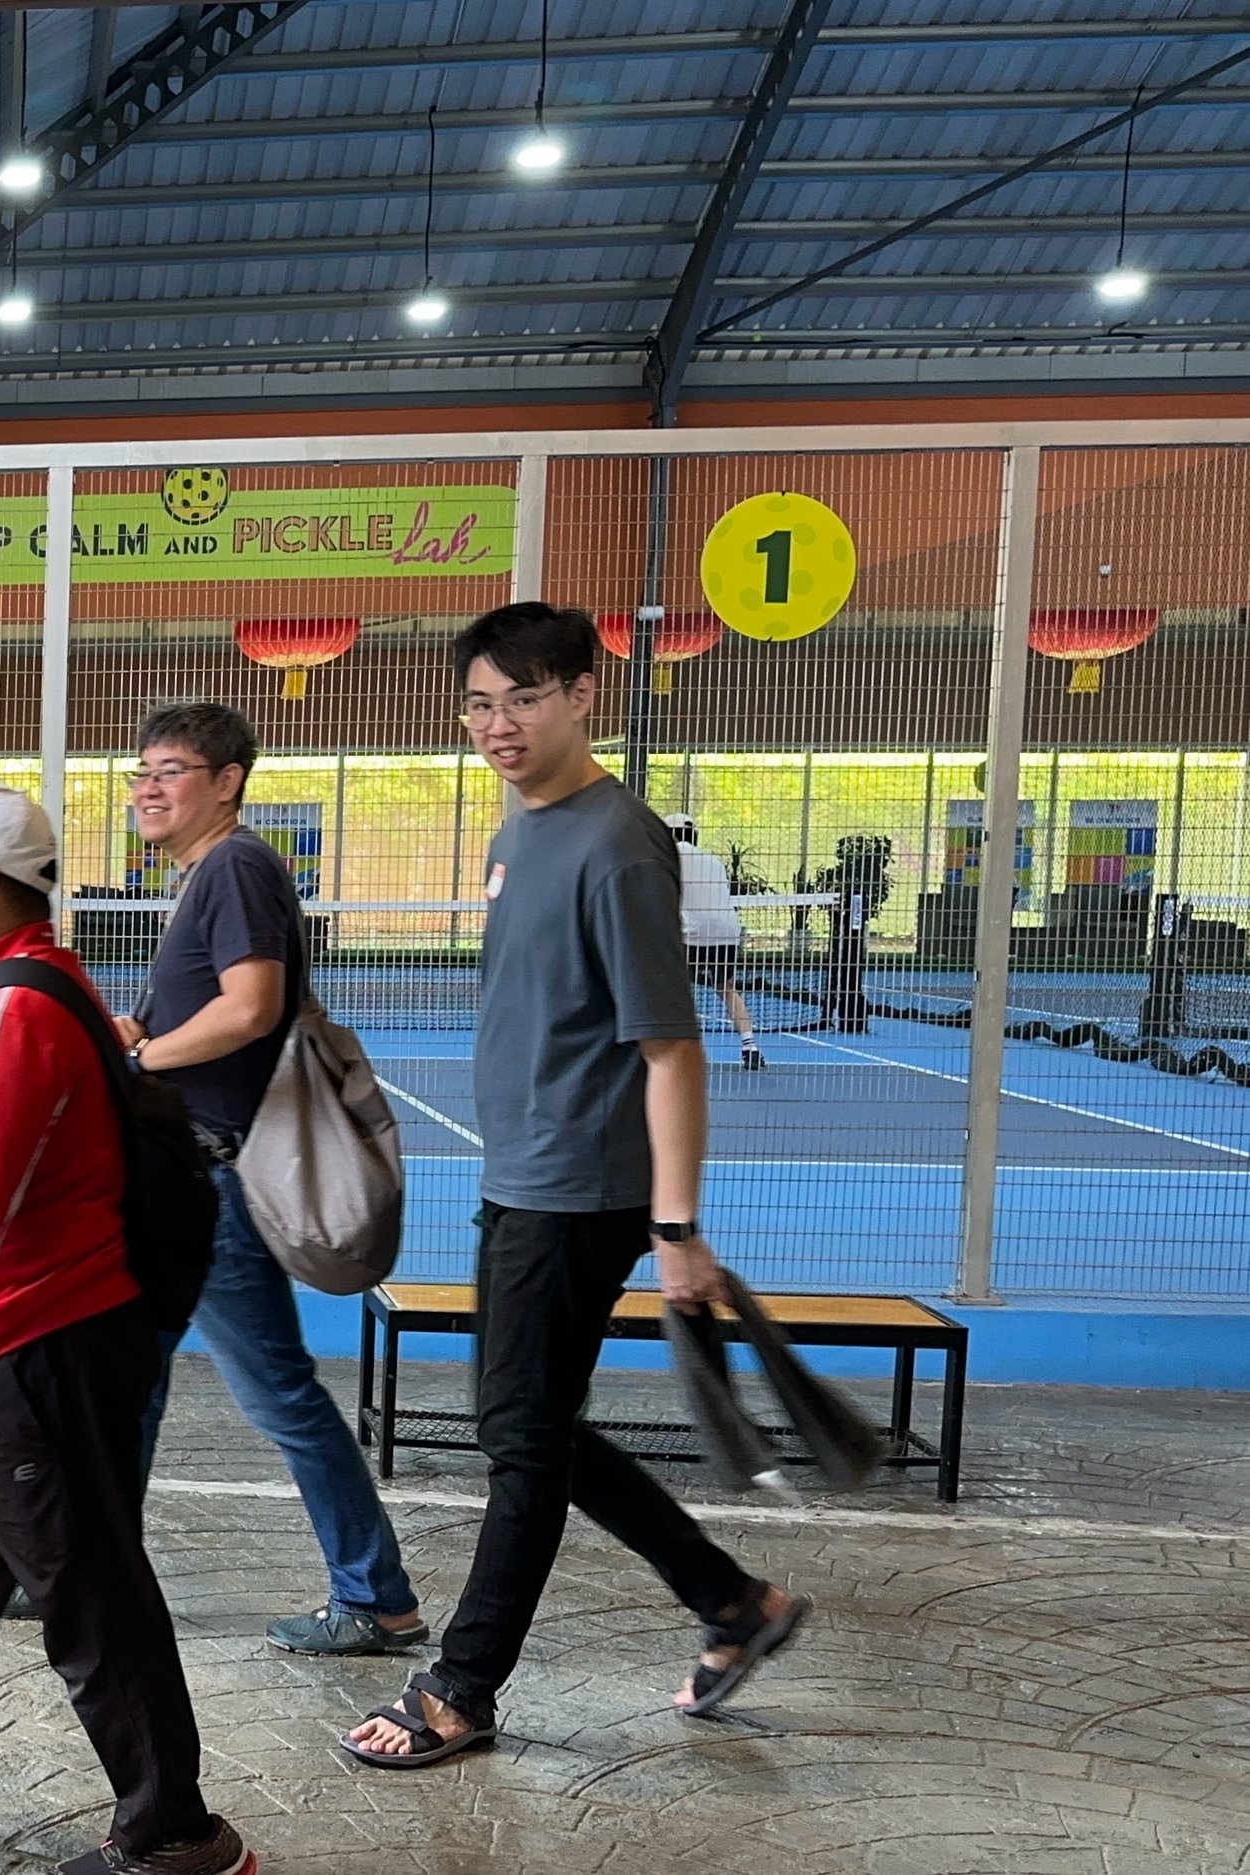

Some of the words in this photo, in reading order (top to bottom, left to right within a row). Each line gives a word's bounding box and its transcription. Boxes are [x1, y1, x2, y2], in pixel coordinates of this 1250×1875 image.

[29, 522, 149, 558] CALM
[164, 535, 218, 555] AND
[232, 513, 393, 554] PICKLE
[756, 530, 792, 604] 1
